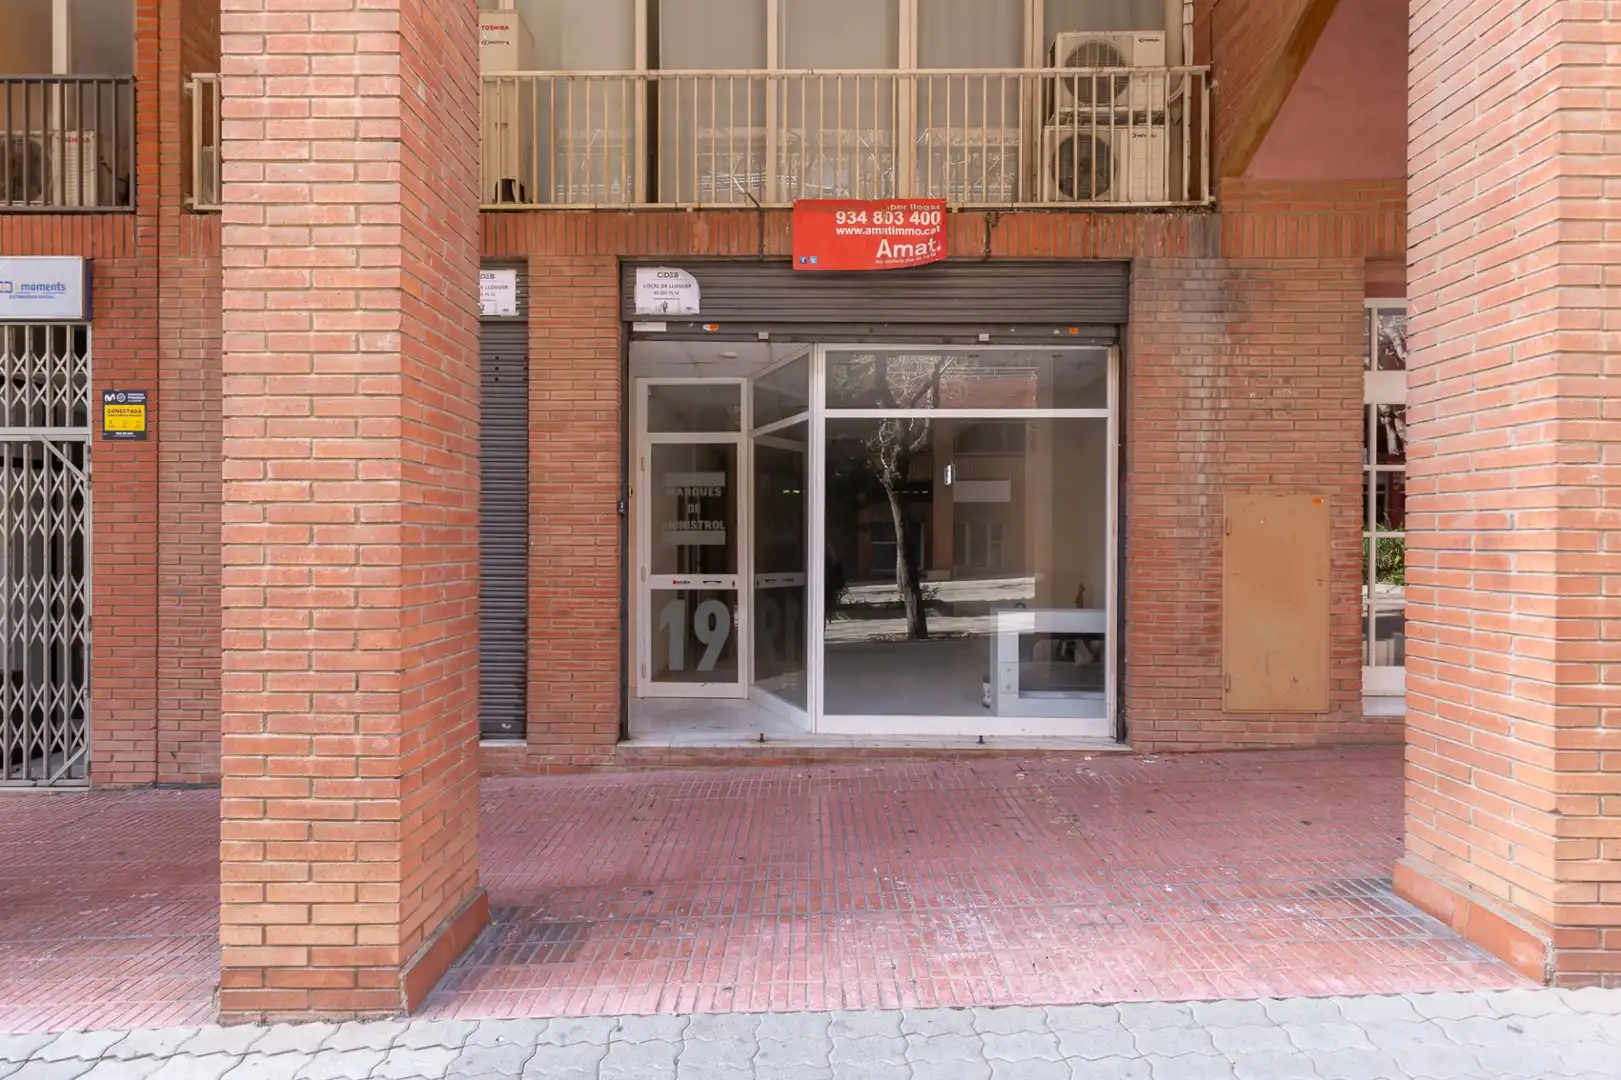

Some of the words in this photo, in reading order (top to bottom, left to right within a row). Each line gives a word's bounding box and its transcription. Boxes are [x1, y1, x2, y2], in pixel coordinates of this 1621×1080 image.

[836, 211, 867, 225] 934
[873, 211, 904, 225] 803
[909, 211, 941, 225] 400
[836, 225, 940, 236] www.amatimmo.cat
[21, 281, 66, 291] moments
[687, 503, 701, 514] DE
[660, 599, 731, 672] 19
